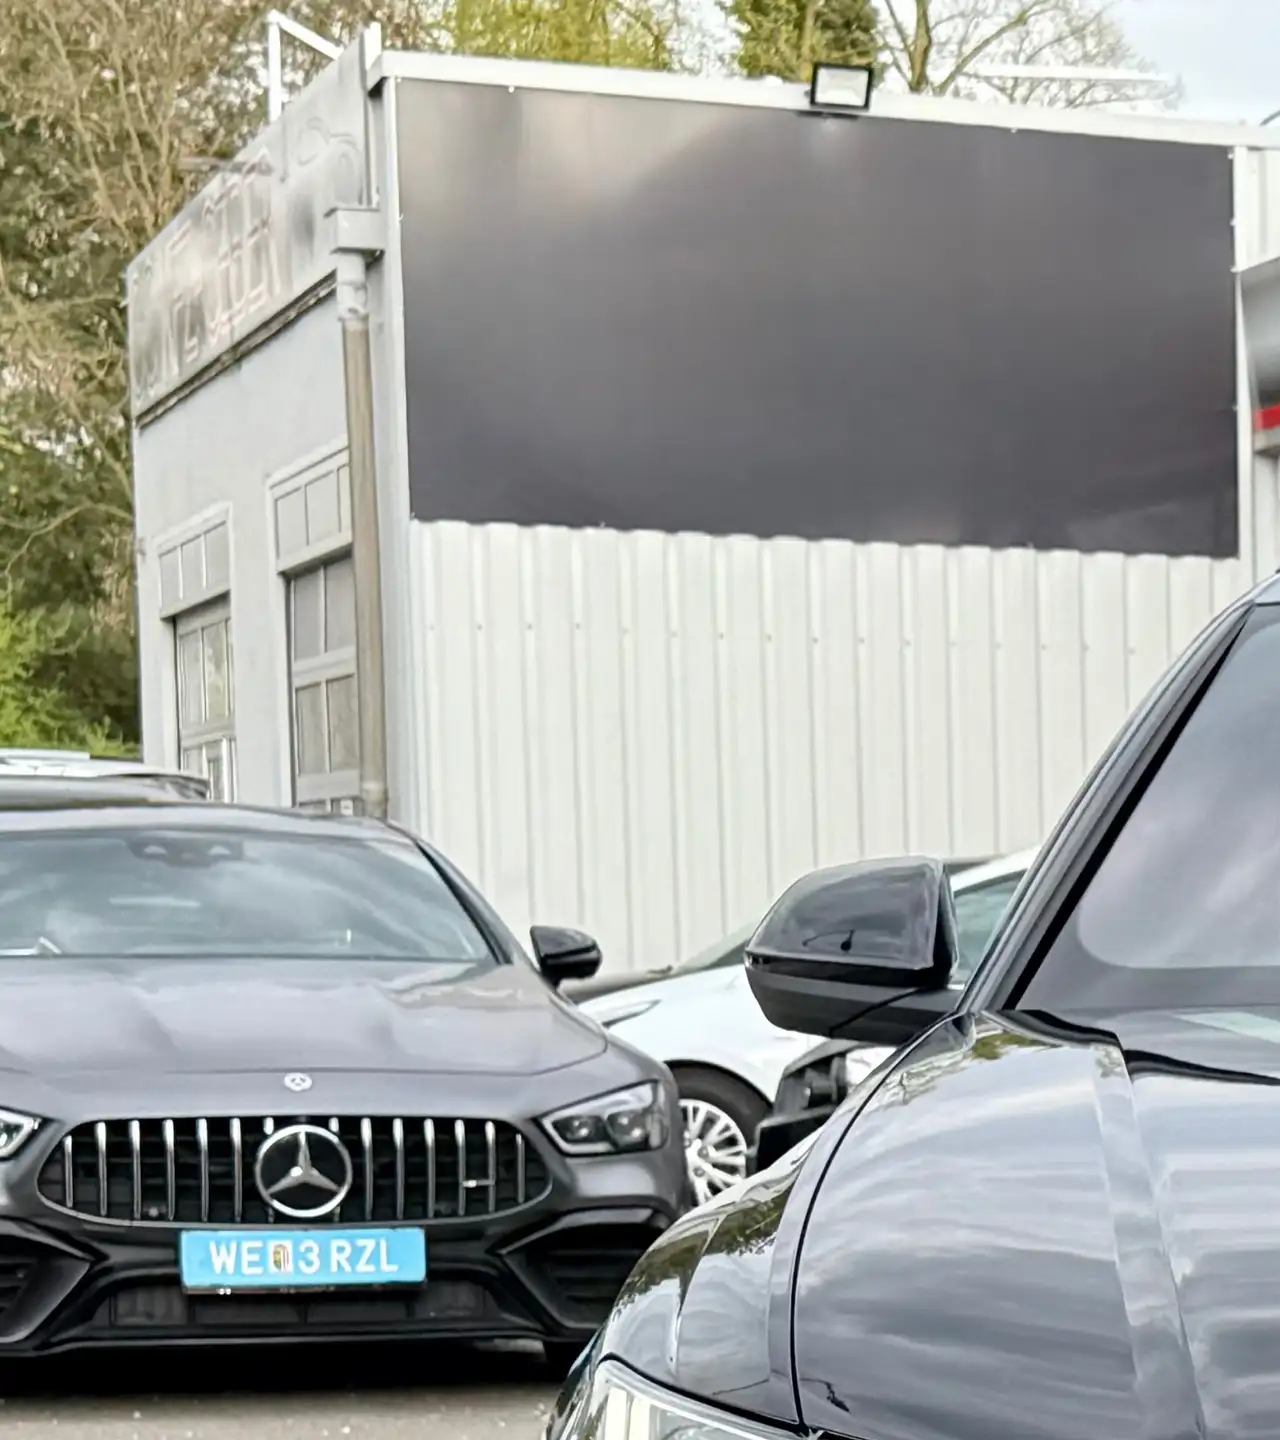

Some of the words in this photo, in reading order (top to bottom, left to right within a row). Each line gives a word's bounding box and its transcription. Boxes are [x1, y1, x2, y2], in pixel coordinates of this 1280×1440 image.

[208, 1239, 264, 1276] WE
[298, 1241, 321, 1275] 3
[330, 1237, 399, 1274] RZL
